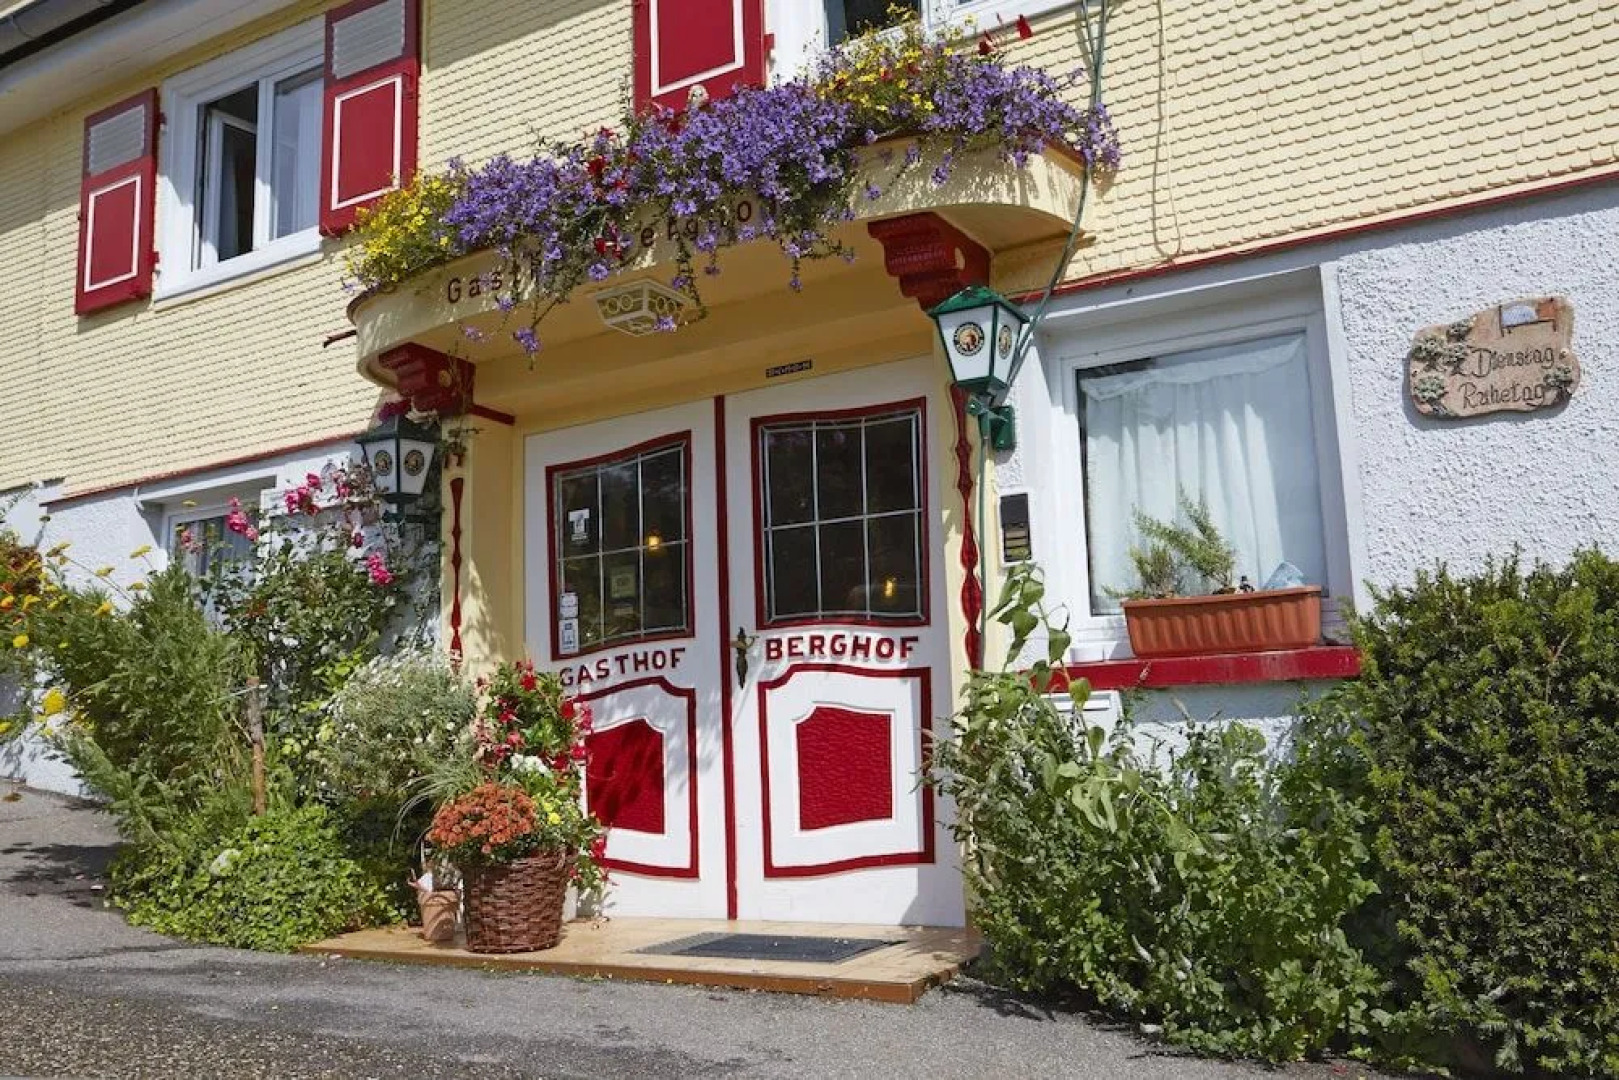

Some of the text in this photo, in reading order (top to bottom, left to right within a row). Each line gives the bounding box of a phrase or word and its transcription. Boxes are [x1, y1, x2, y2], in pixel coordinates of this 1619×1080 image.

[1471, 347, 1554, 378] Dienstag
[1458, 381, 1546, 409] Ruhetag
[559, 634, 919, 687] GASTHOF BERGHOF
